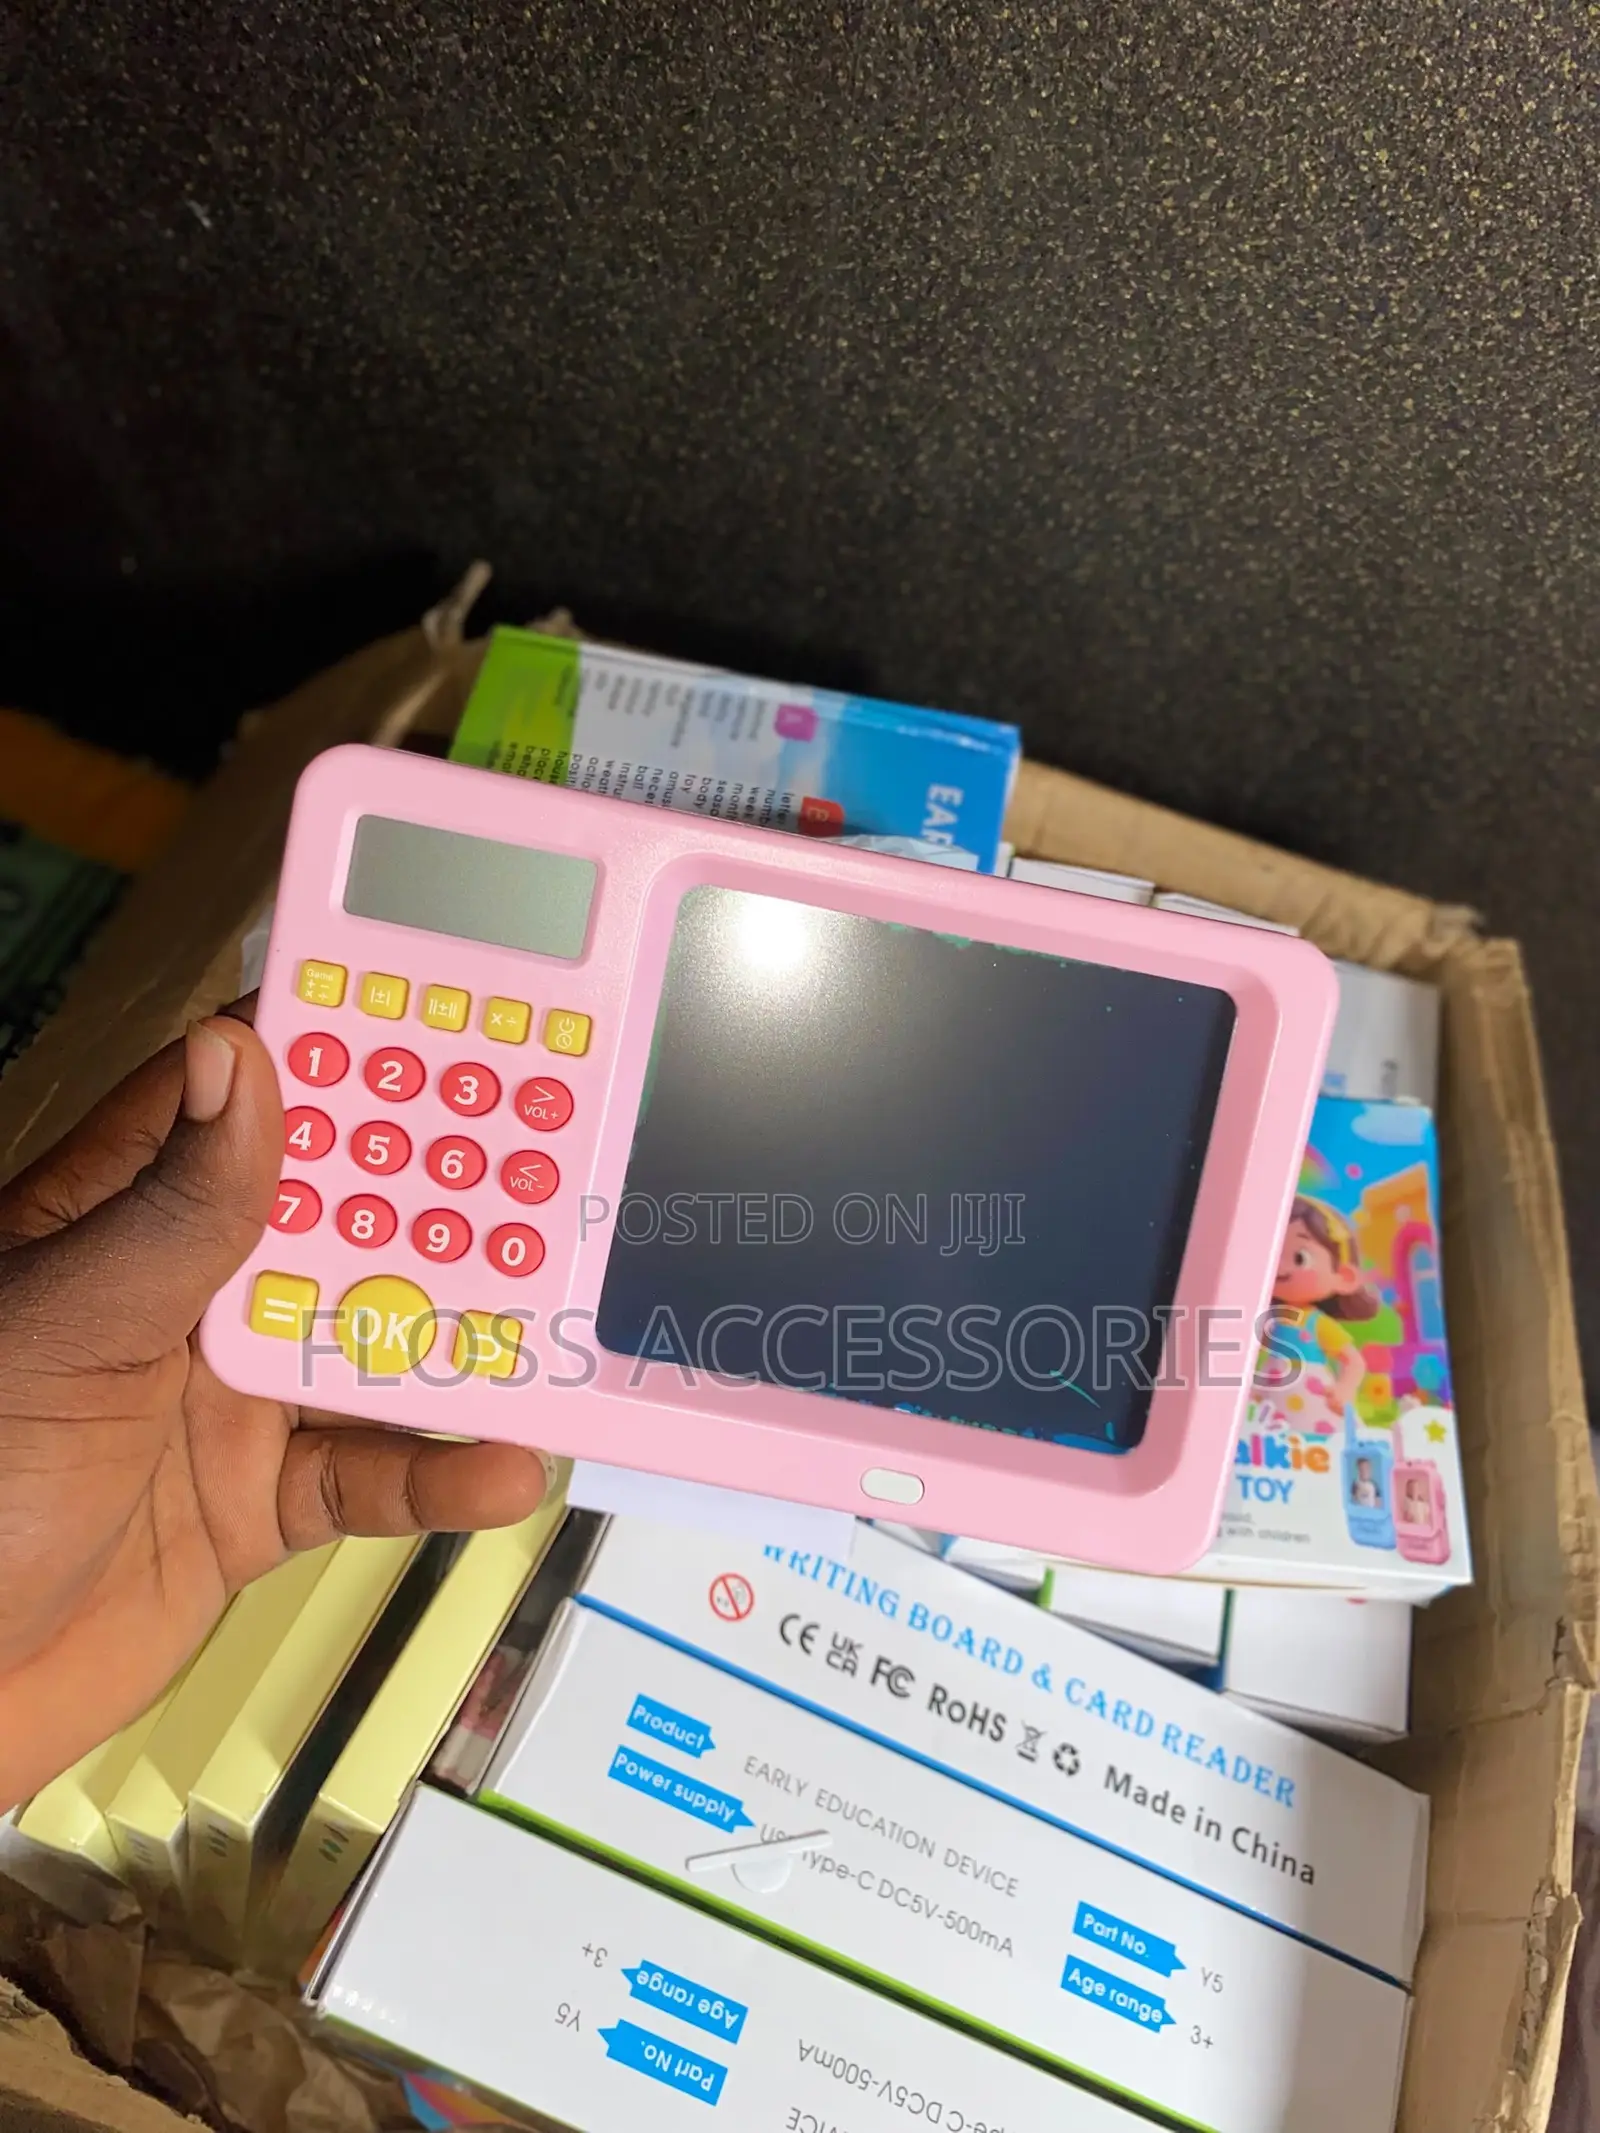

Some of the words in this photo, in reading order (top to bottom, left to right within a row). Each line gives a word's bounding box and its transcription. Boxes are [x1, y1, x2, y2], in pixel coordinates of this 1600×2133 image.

[581, 756, 599, 791] actio
[613, 761, 631, 799] instru
[633, 764, 650, 791] ball
[682, 773, 697, 795] toy
[693, 776, 713, 811] body
[710, 779, 728, 817] seaso
[758, 788, 776, 827] numb
[306, 968, 334, 982] Game
[308, 1046, 324, 1079] 1
[377, 1060, 404, 1093] 2
[452, 1074, 480, 1107] 3
[288, 1121, 313, 1152] 4
[364, 1135, 391, 1166] 5
[439, 1148, 467, 1181] 6
[277, 1194, 302, 1225] 7
[350, 1208, 376, 1241] 8
[426, 1222, 452, 1255] 9
[501, 1236, 527, 1268] 0
[351, 1310, 416, 1355] OK
[1238, 1476, 1294, 1504] TOY
[779, 1612, 821, 1656] CE
[907, 1602, 1024, 1677] BOARD
[1030, 1662, 1054, 1694] &
[1063, 1677, 1156, 1740] CARD
[1160, 1721, 1298, 1810] READER
[926, 1682, 1008, 1745] RoHS
[632, 1703, 706, 1750] Product
[614, 1752, 672, 1793] Power
[672, 1780, 737, 1824] supply
[742, 1755, 810, 1799] EARLY
[814, 1787, 937, 1860] EDUCATION
[942, 1847, 1020, 1899] DEVICE
[1103, 1763, 1187, 1825] Made
[1193, 1806, 1222, 1842] in
[1231, 1826, 1317, 1887] China
[876, 1877, 1015, 1959] DC5V-500mA
[1082, 1912, 1119, 1943] Part
[1120, 1930, 1151, 1959] No.
[581, 1942, 609, 1969] 3+
[635, 1969, 696, 2008] range
[1067, 1966, 1107, 1997] Age
[1108, 1987, 1165, 2025] range
[1200, 1965, 1225, 1995] Y5
[554, 2001, 582, 2033] Y5
[697, 1997, 740, 2031] Age
[1189, 2023, 1215, 2050] 3+
[639, 2039, 673, 2074] No.
[673, 2057, 716, 2093] Part
[798, 2038, 944, 2125] DC5V-500mA
